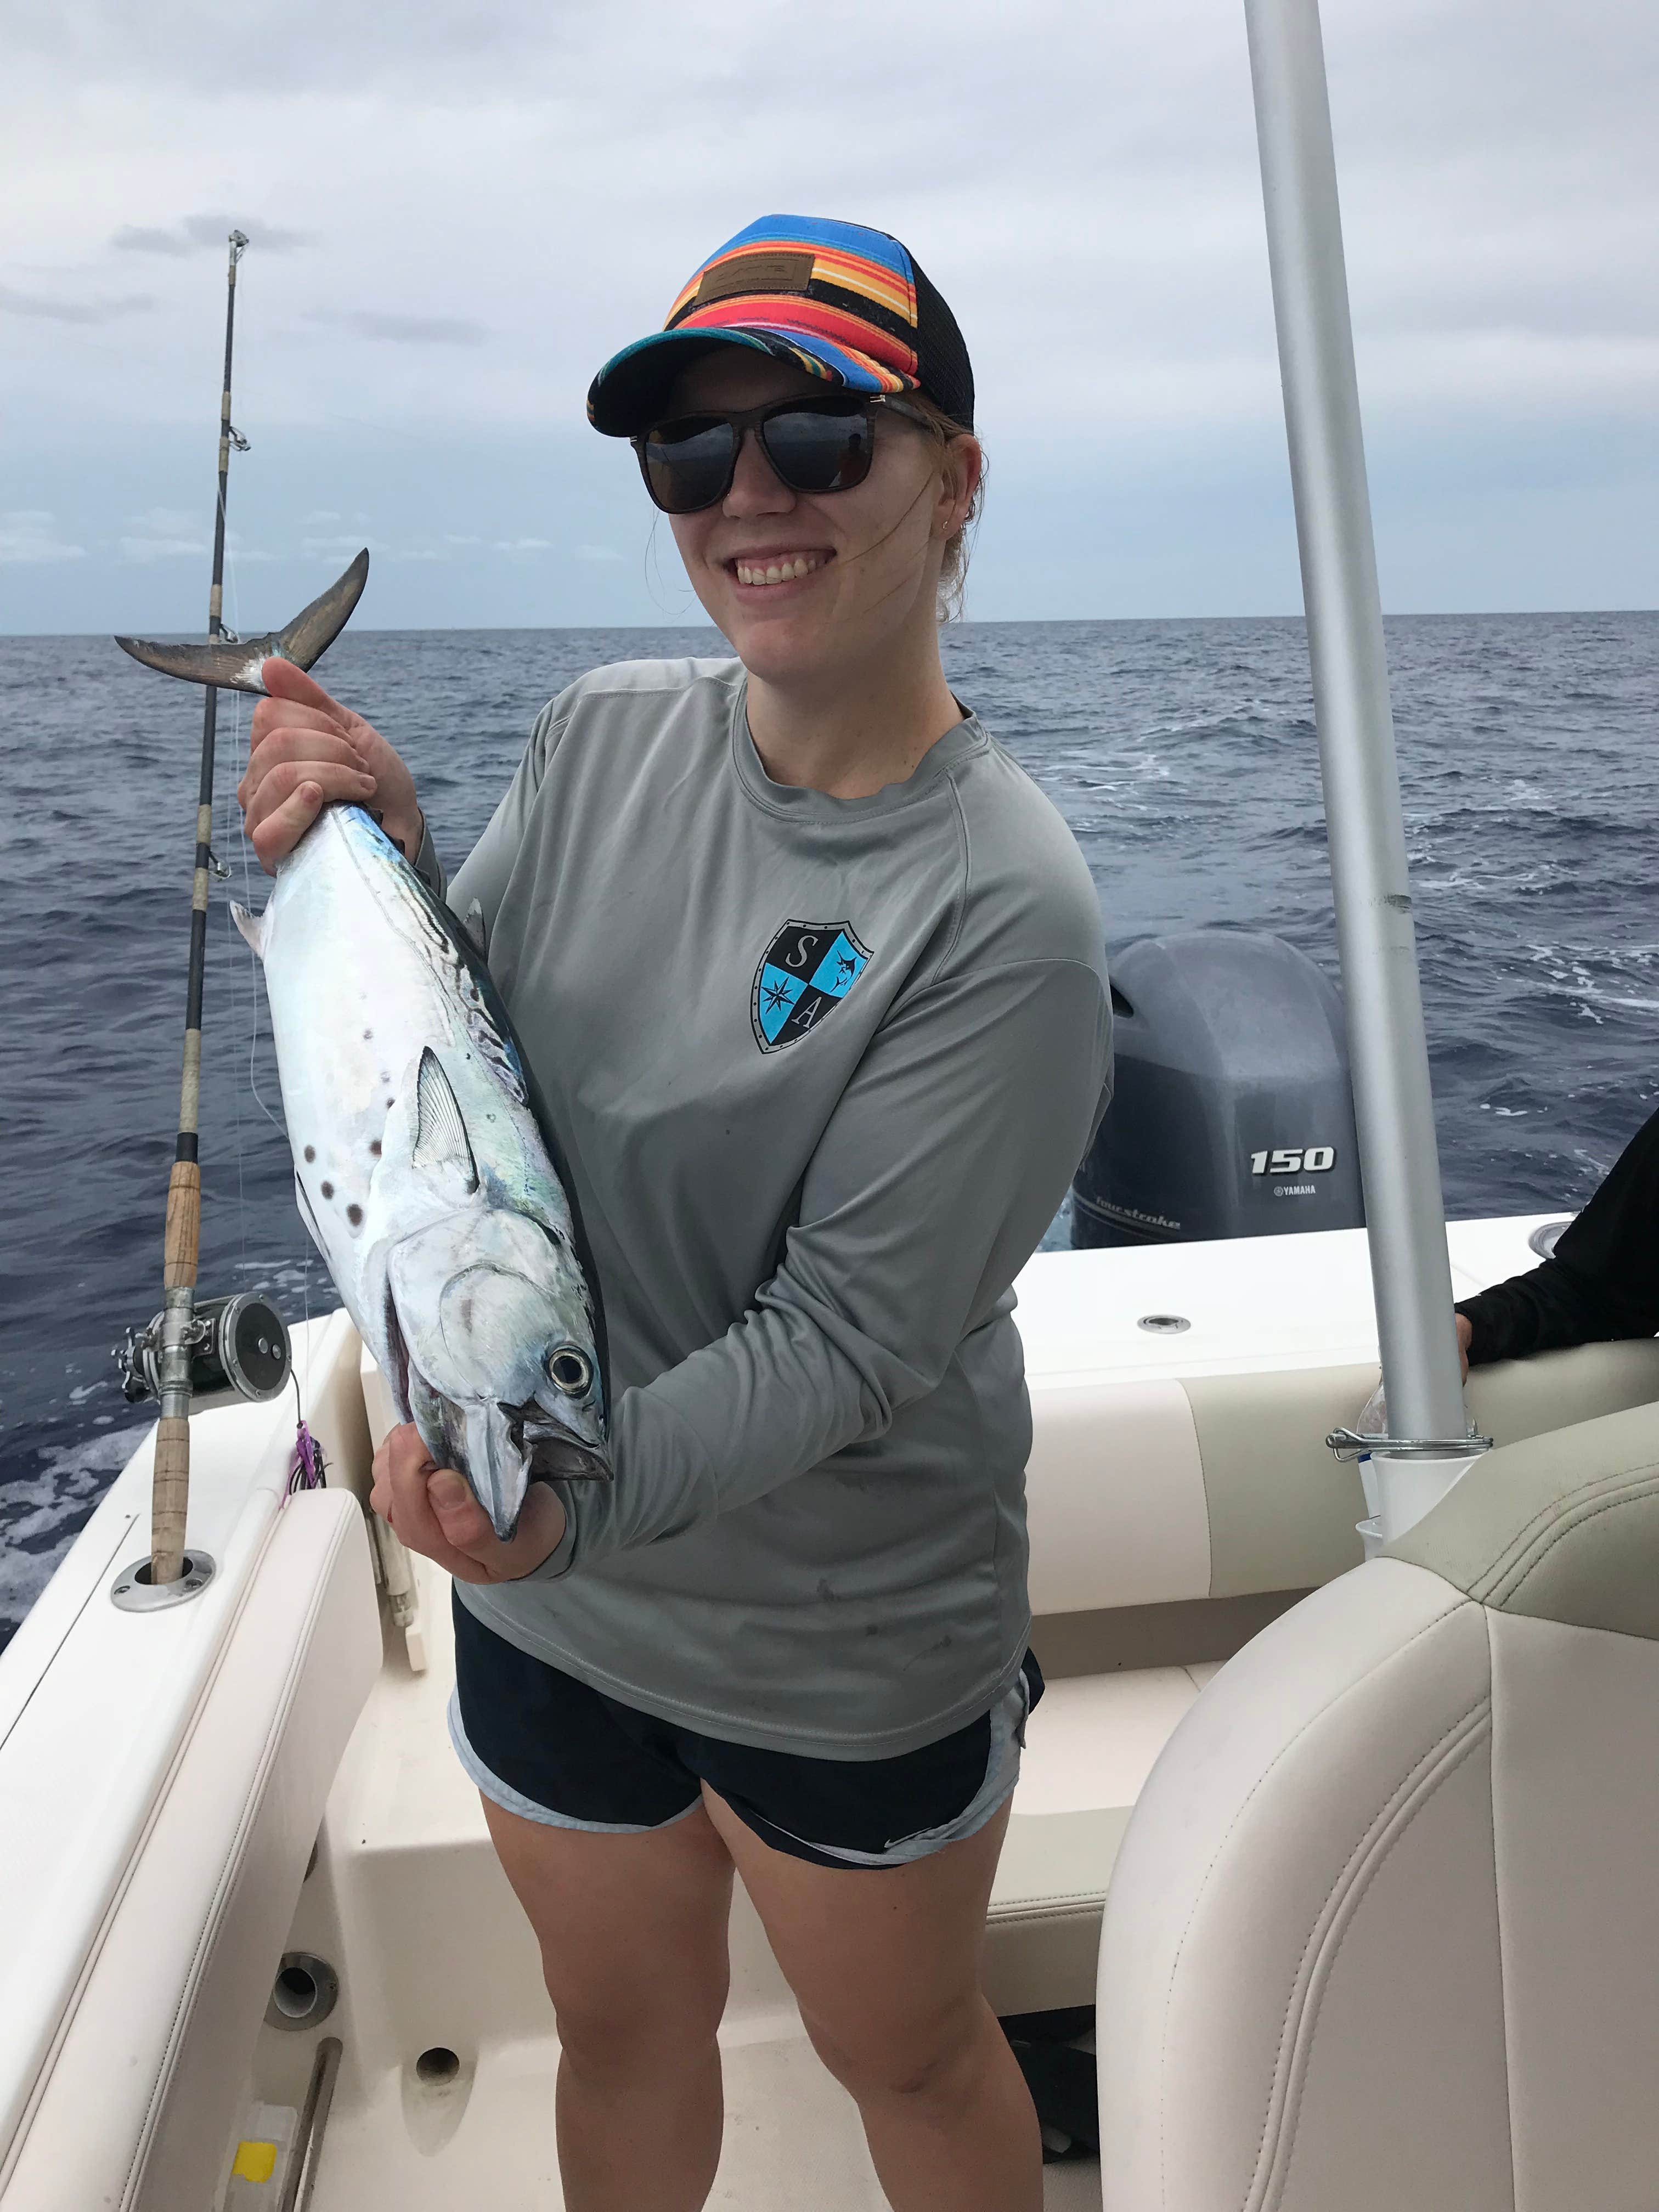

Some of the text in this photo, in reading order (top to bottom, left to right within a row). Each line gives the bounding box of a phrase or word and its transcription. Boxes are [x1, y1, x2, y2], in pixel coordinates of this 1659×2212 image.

[785, 935, 819, 967] S
[791, 996, 822, 1029] A
[1250, 1146, 1335, 1174] 150
[1283, 1184, 1316, 1196] YAMAHA
